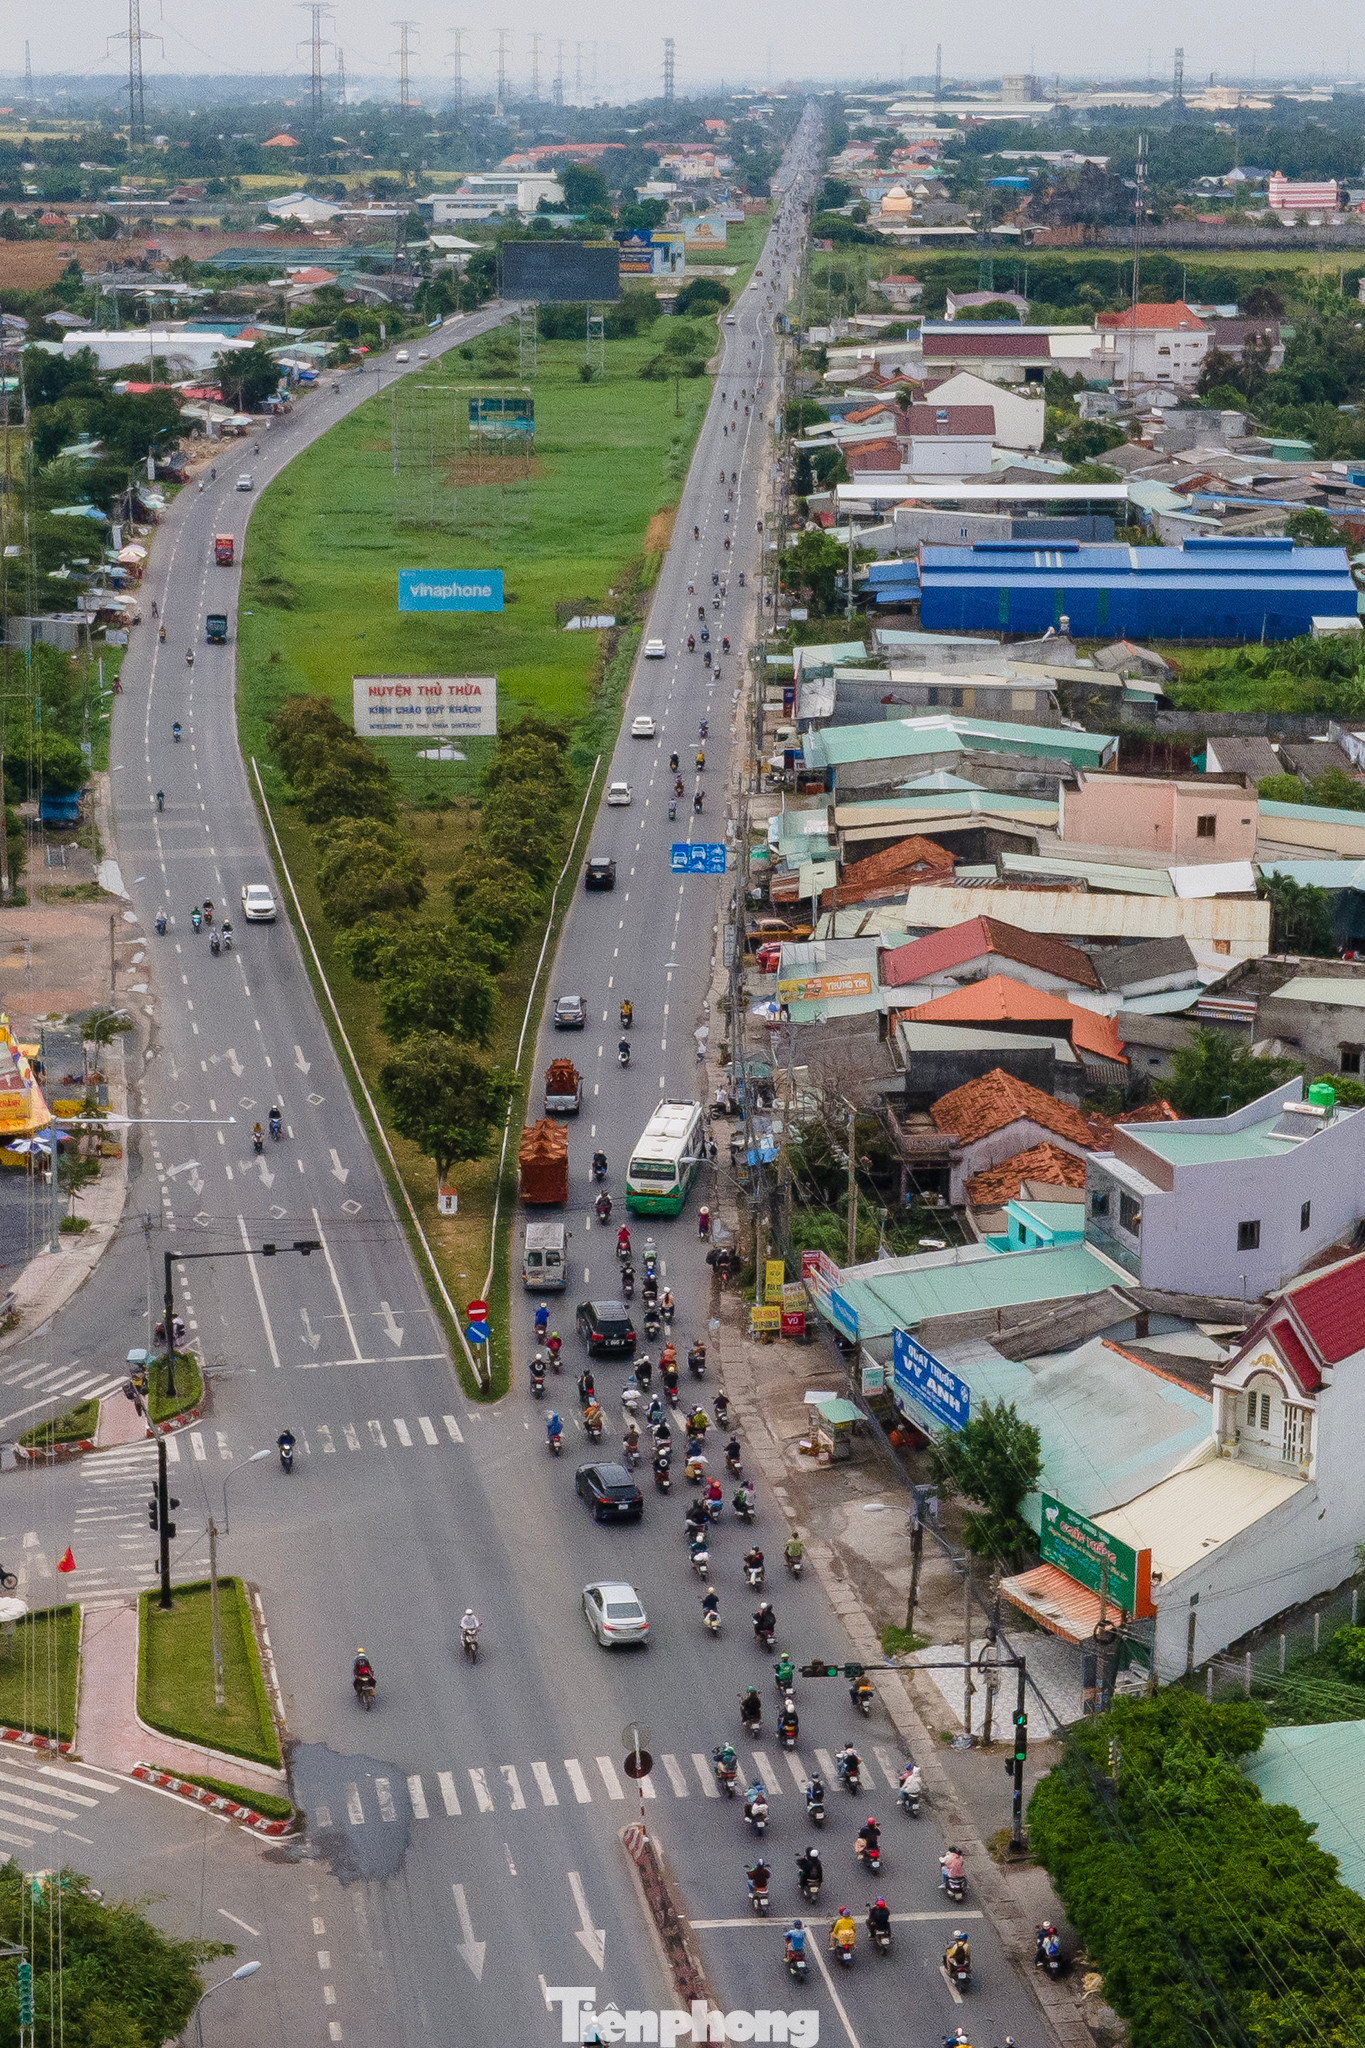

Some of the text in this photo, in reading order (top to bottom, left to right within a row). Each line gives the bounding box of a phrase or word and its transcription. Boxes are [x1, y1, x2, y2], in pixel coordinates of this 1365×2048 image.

[410, 582, 492, 599] vinaphone
[417, 682, 442, 696] THỦ
[448, 683, 481, 696] THỪA
[926, 1377, 961, 1413] ANH
